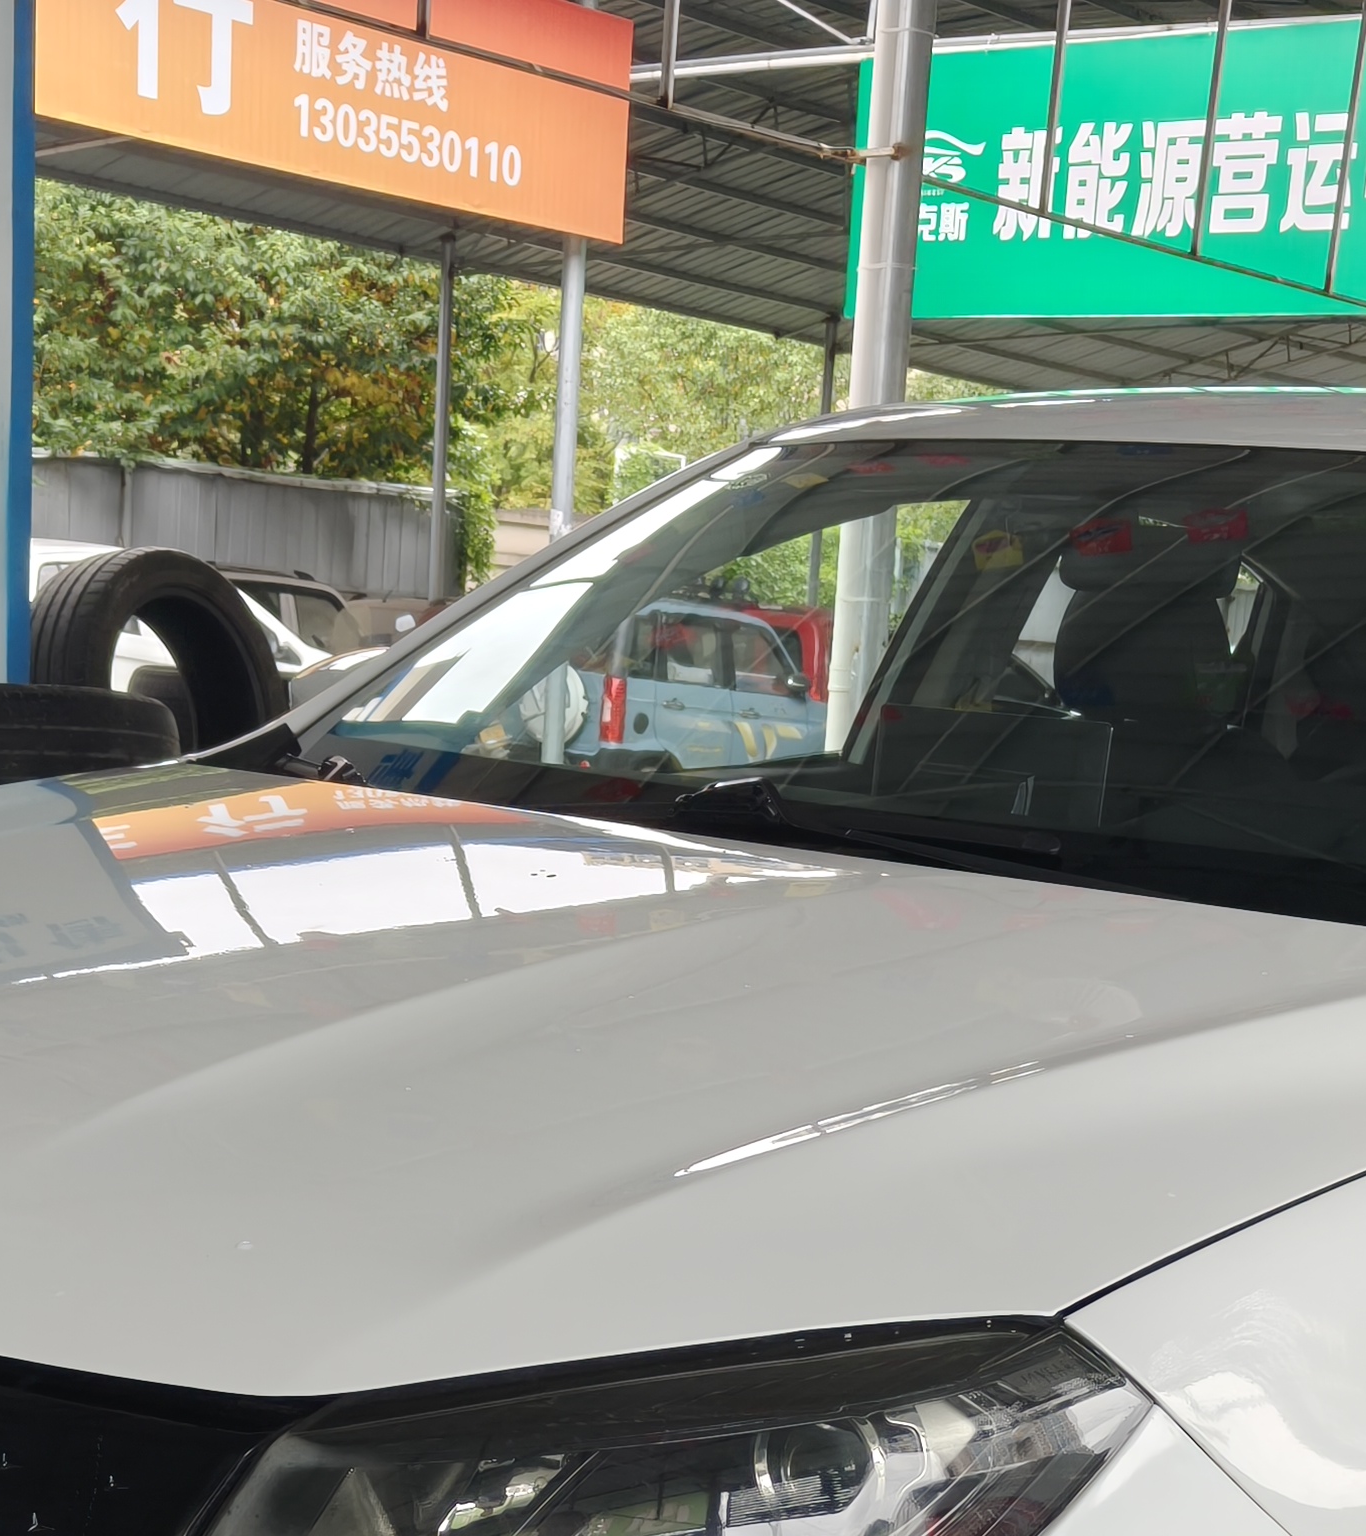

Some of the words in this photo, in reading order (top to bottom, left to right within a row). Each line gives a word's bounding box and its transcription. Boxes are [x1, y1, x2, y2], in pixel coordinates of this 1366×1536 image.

[293, 18, 449, 112] 服务热线
[293, 93, 522, 187] 13035530110
